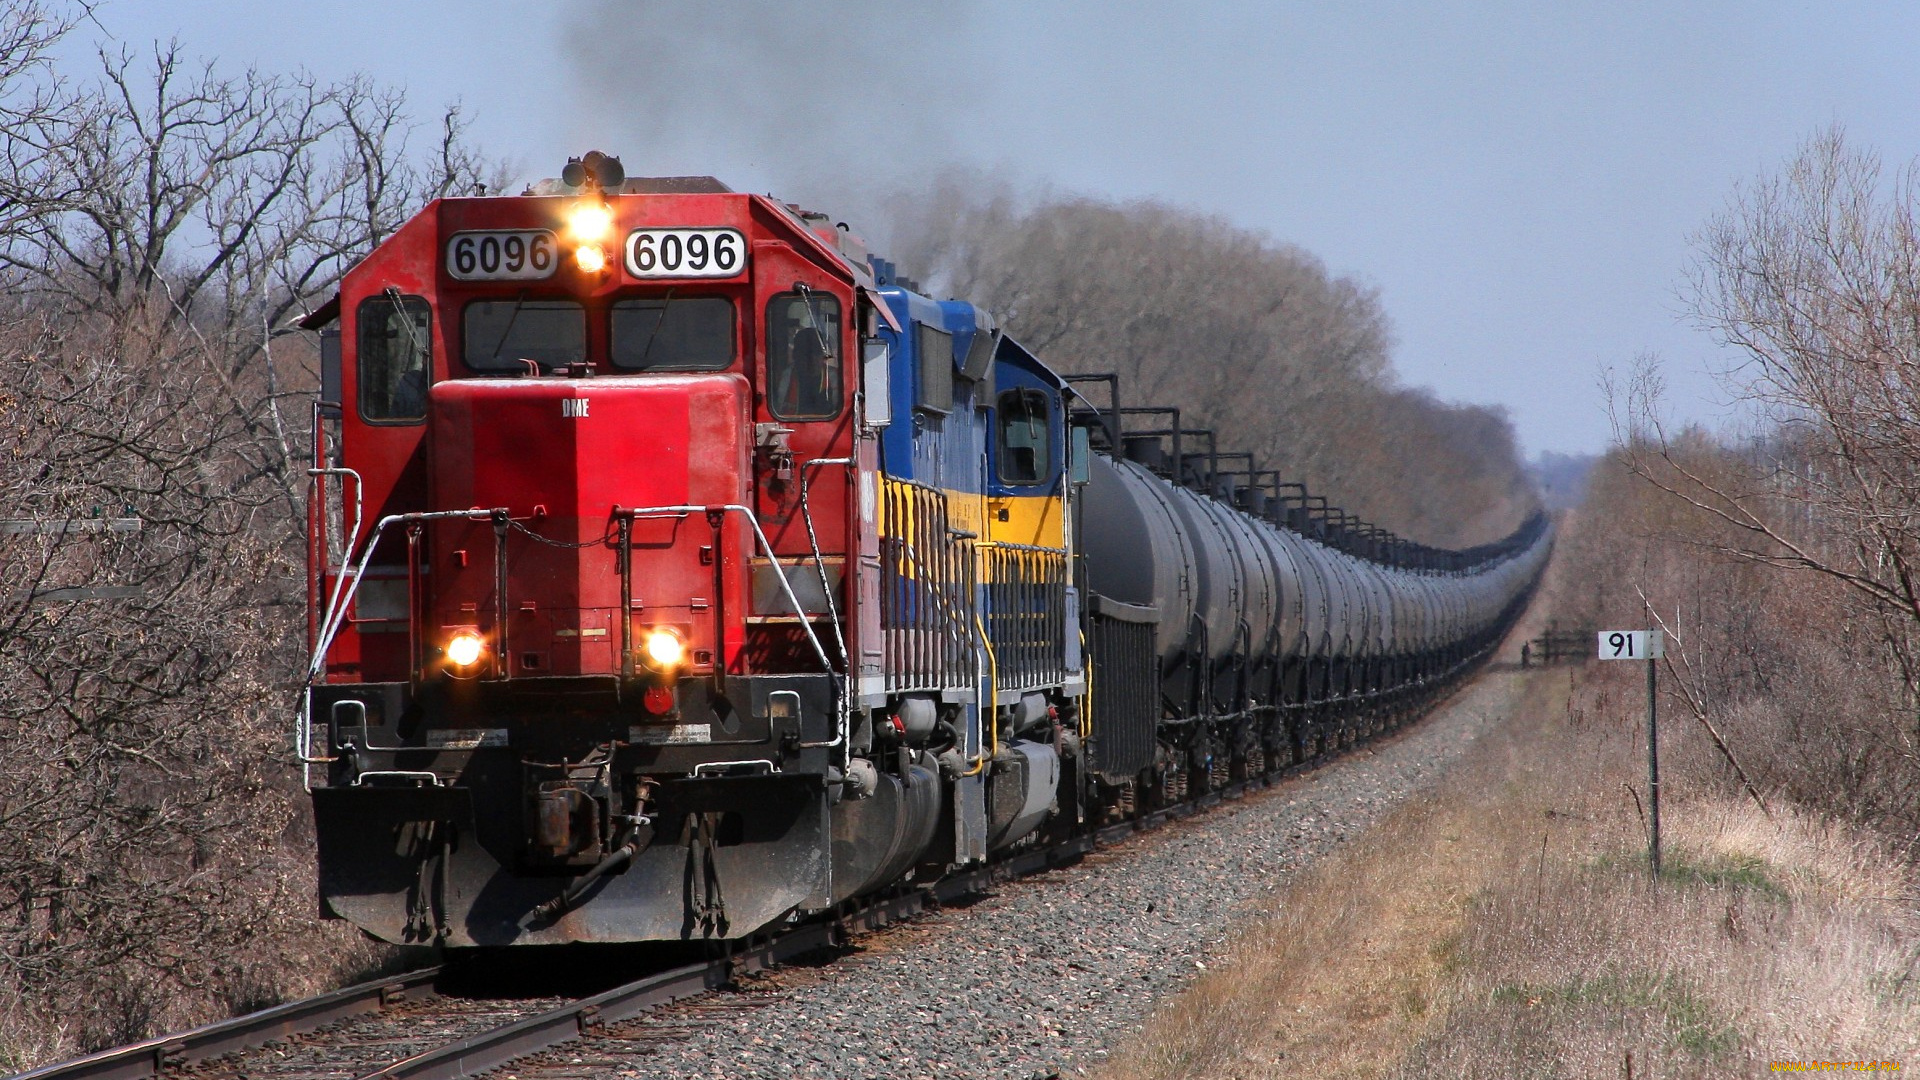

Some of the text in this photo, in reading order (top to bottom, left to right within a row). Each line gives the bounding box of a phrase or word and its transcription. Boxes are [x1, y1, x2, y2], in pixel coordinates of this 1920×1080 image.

[455, 235, 551, 273] 6096
[633, 233, 736, 271] 6096
[562, 398, 589, 417] DME
[1608, 632, 1634, 657] 91
